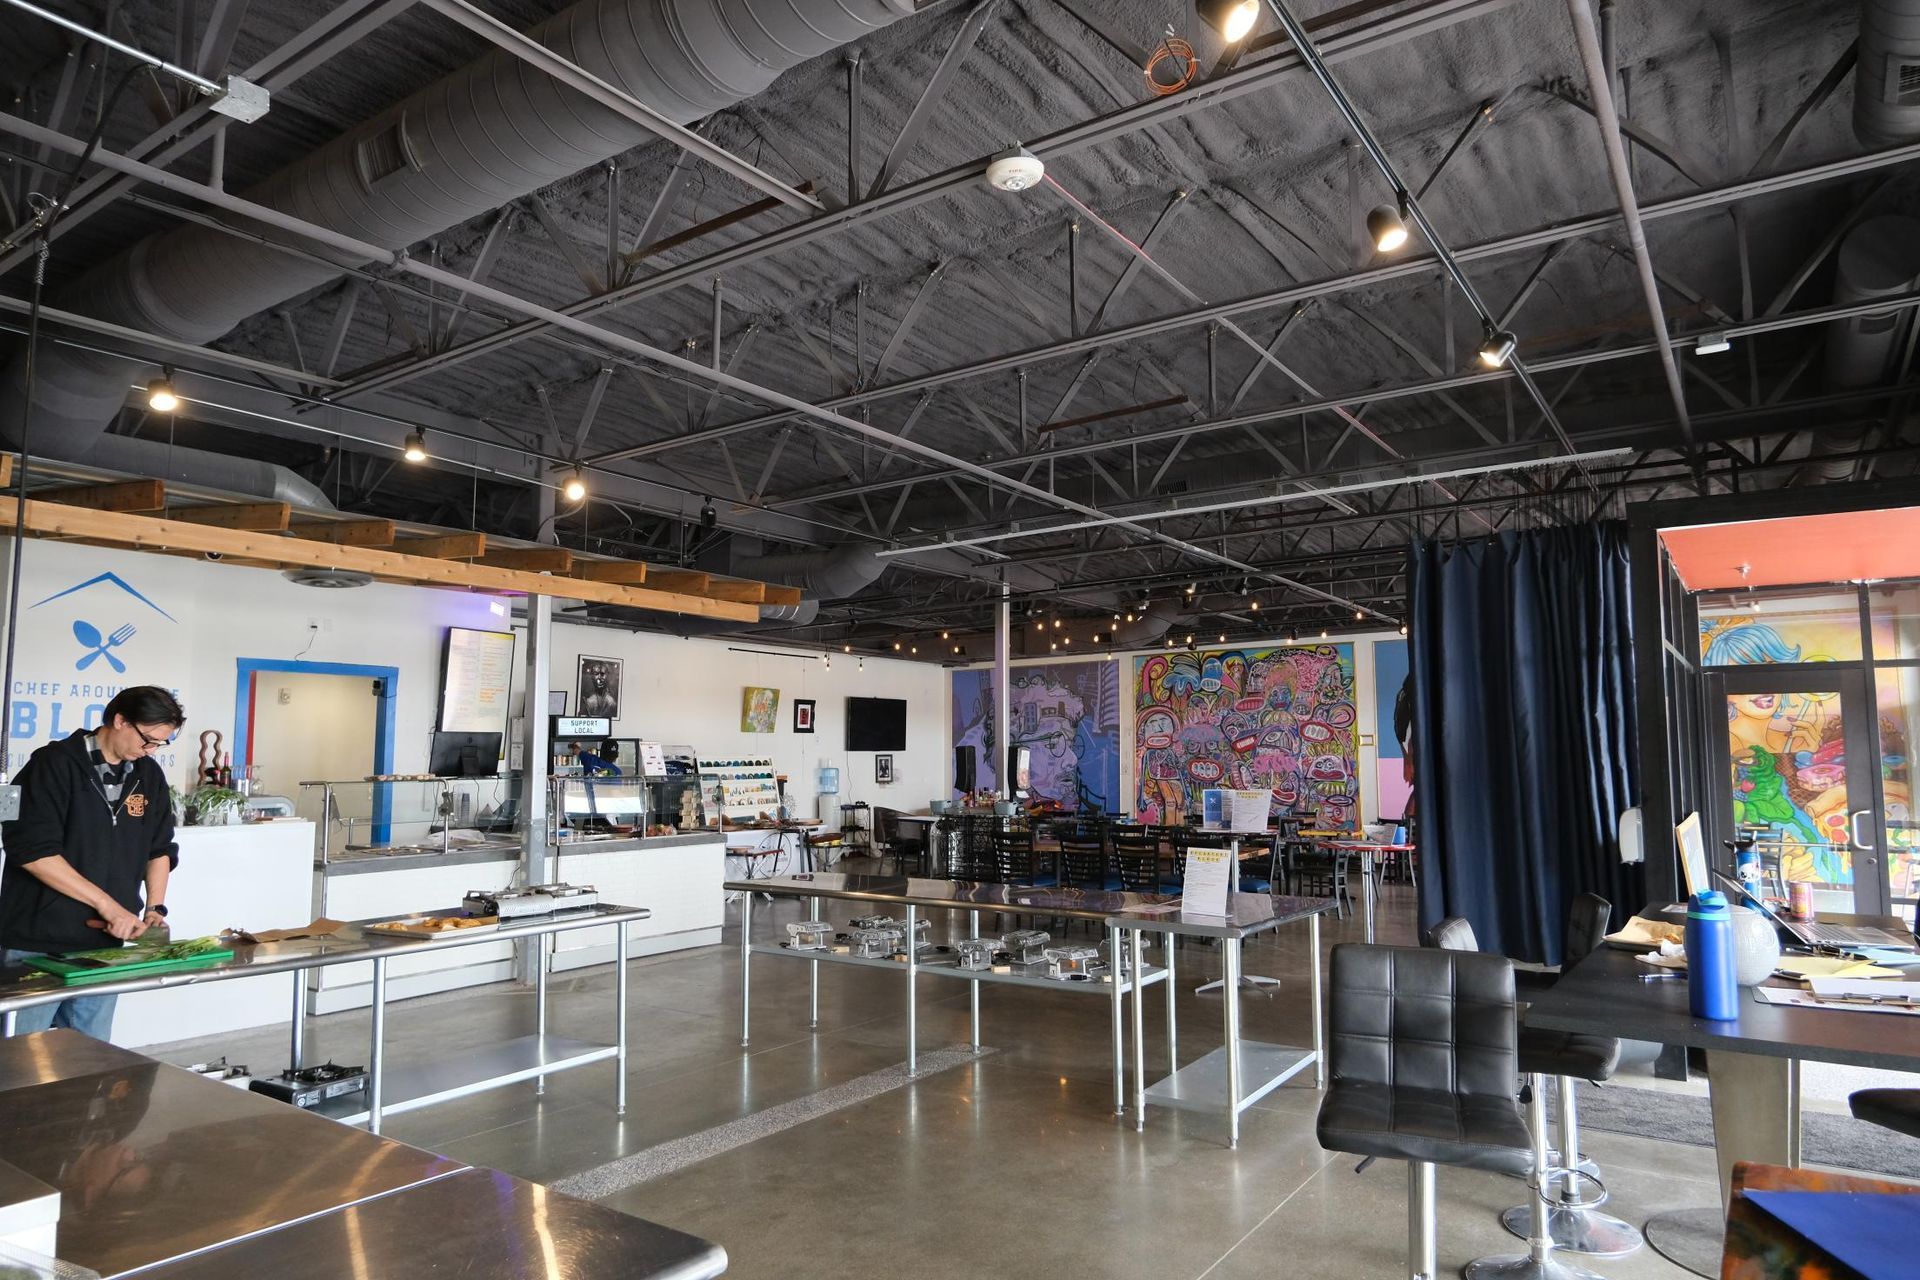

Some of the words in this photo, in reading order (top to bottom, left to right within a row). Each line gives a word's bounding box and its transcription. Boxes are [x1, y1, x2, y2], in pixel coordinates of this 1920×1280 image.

[14, 682, 60, 695] CHEF
[70, 684, 121, 698] AROU
[9, 701, 105, 739] BLO
